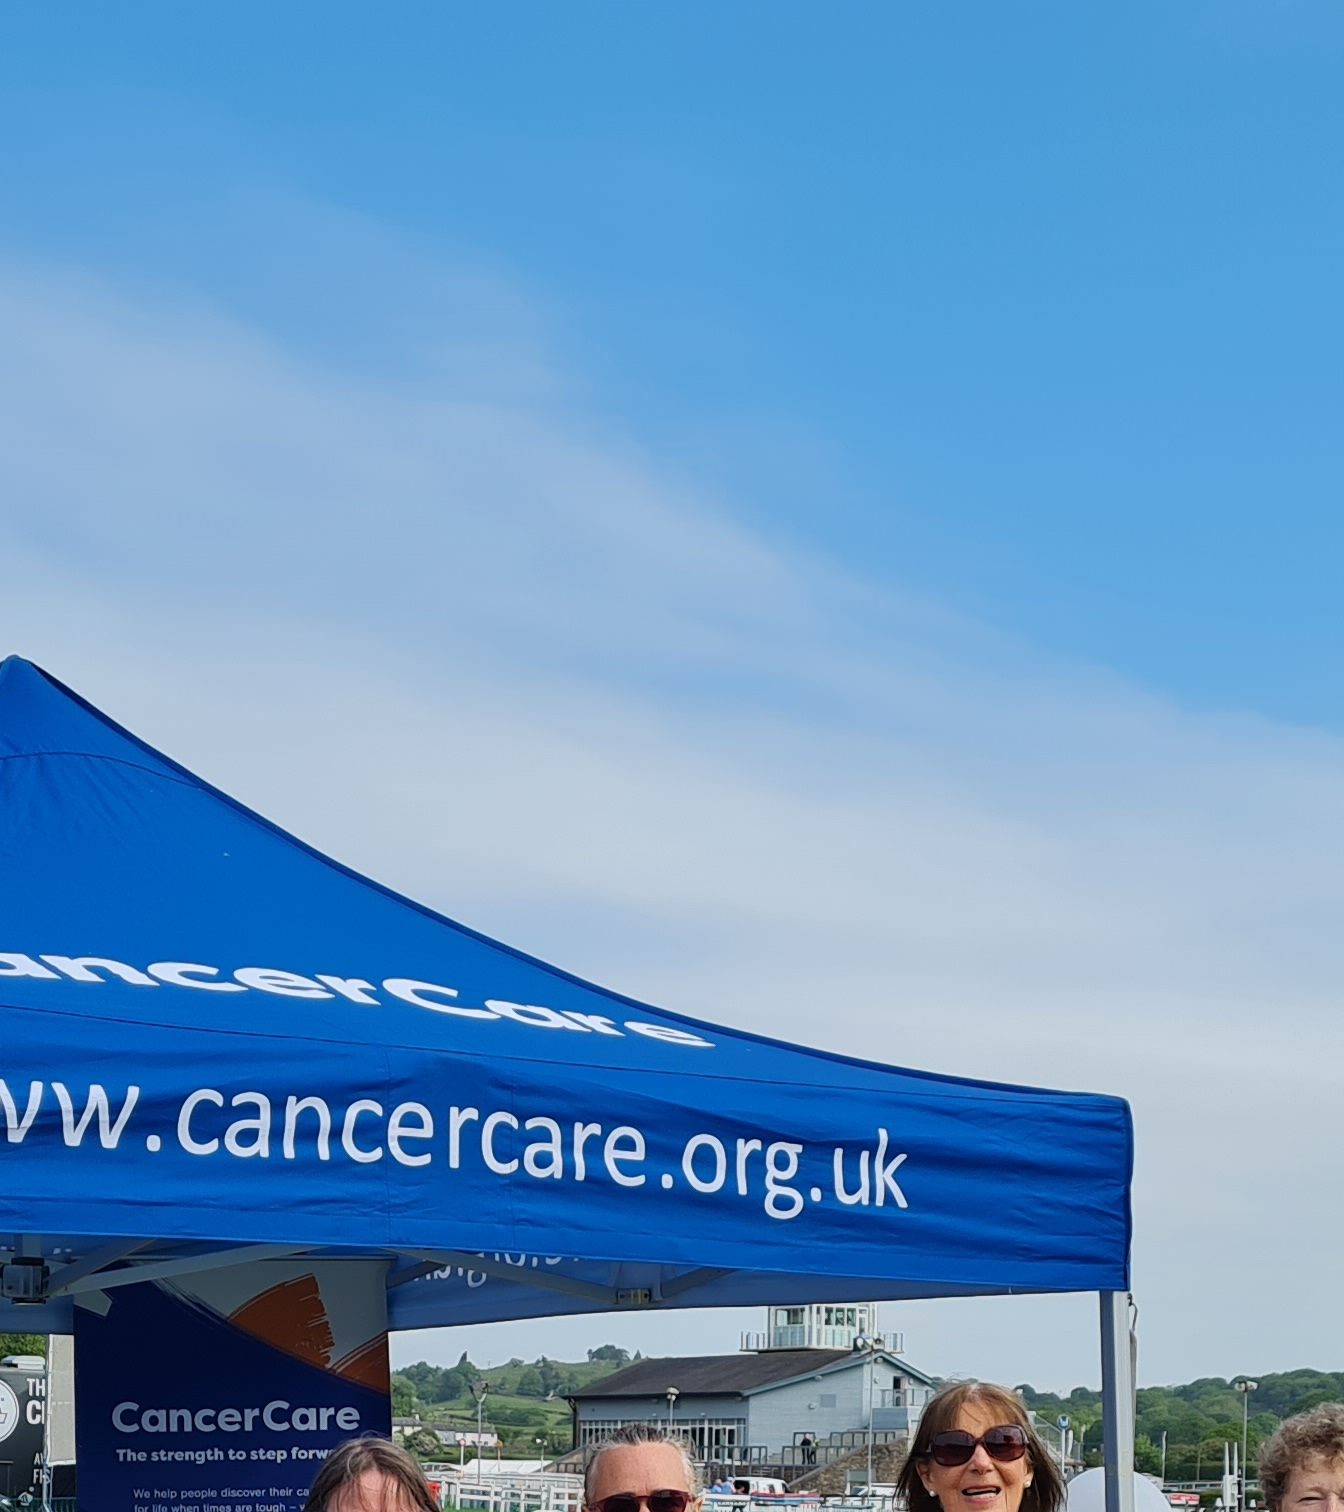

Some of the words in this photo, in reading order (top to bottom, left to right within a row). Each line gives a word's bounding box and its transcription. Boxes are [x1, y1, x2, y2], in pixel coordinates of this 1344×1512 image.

[112, 1400, 360, 1432] CancerCare
[116, 1448, 148, 1462] The
[151, 1447, 224, 1465] strength
[228, 1448, 247, 1460] to
[250, 1448, 288, 1464] step
[133, 1489, 150, 1498] We
[154, 1488, 178, 1500] help
[180, 1488, 218, 1500] people
[220, 1487, 266, 1498] discover
[269, 1486, 294, 1497] their
[203, 1503, 232, 1512] times
[234, 1504, 252, 1512] are
